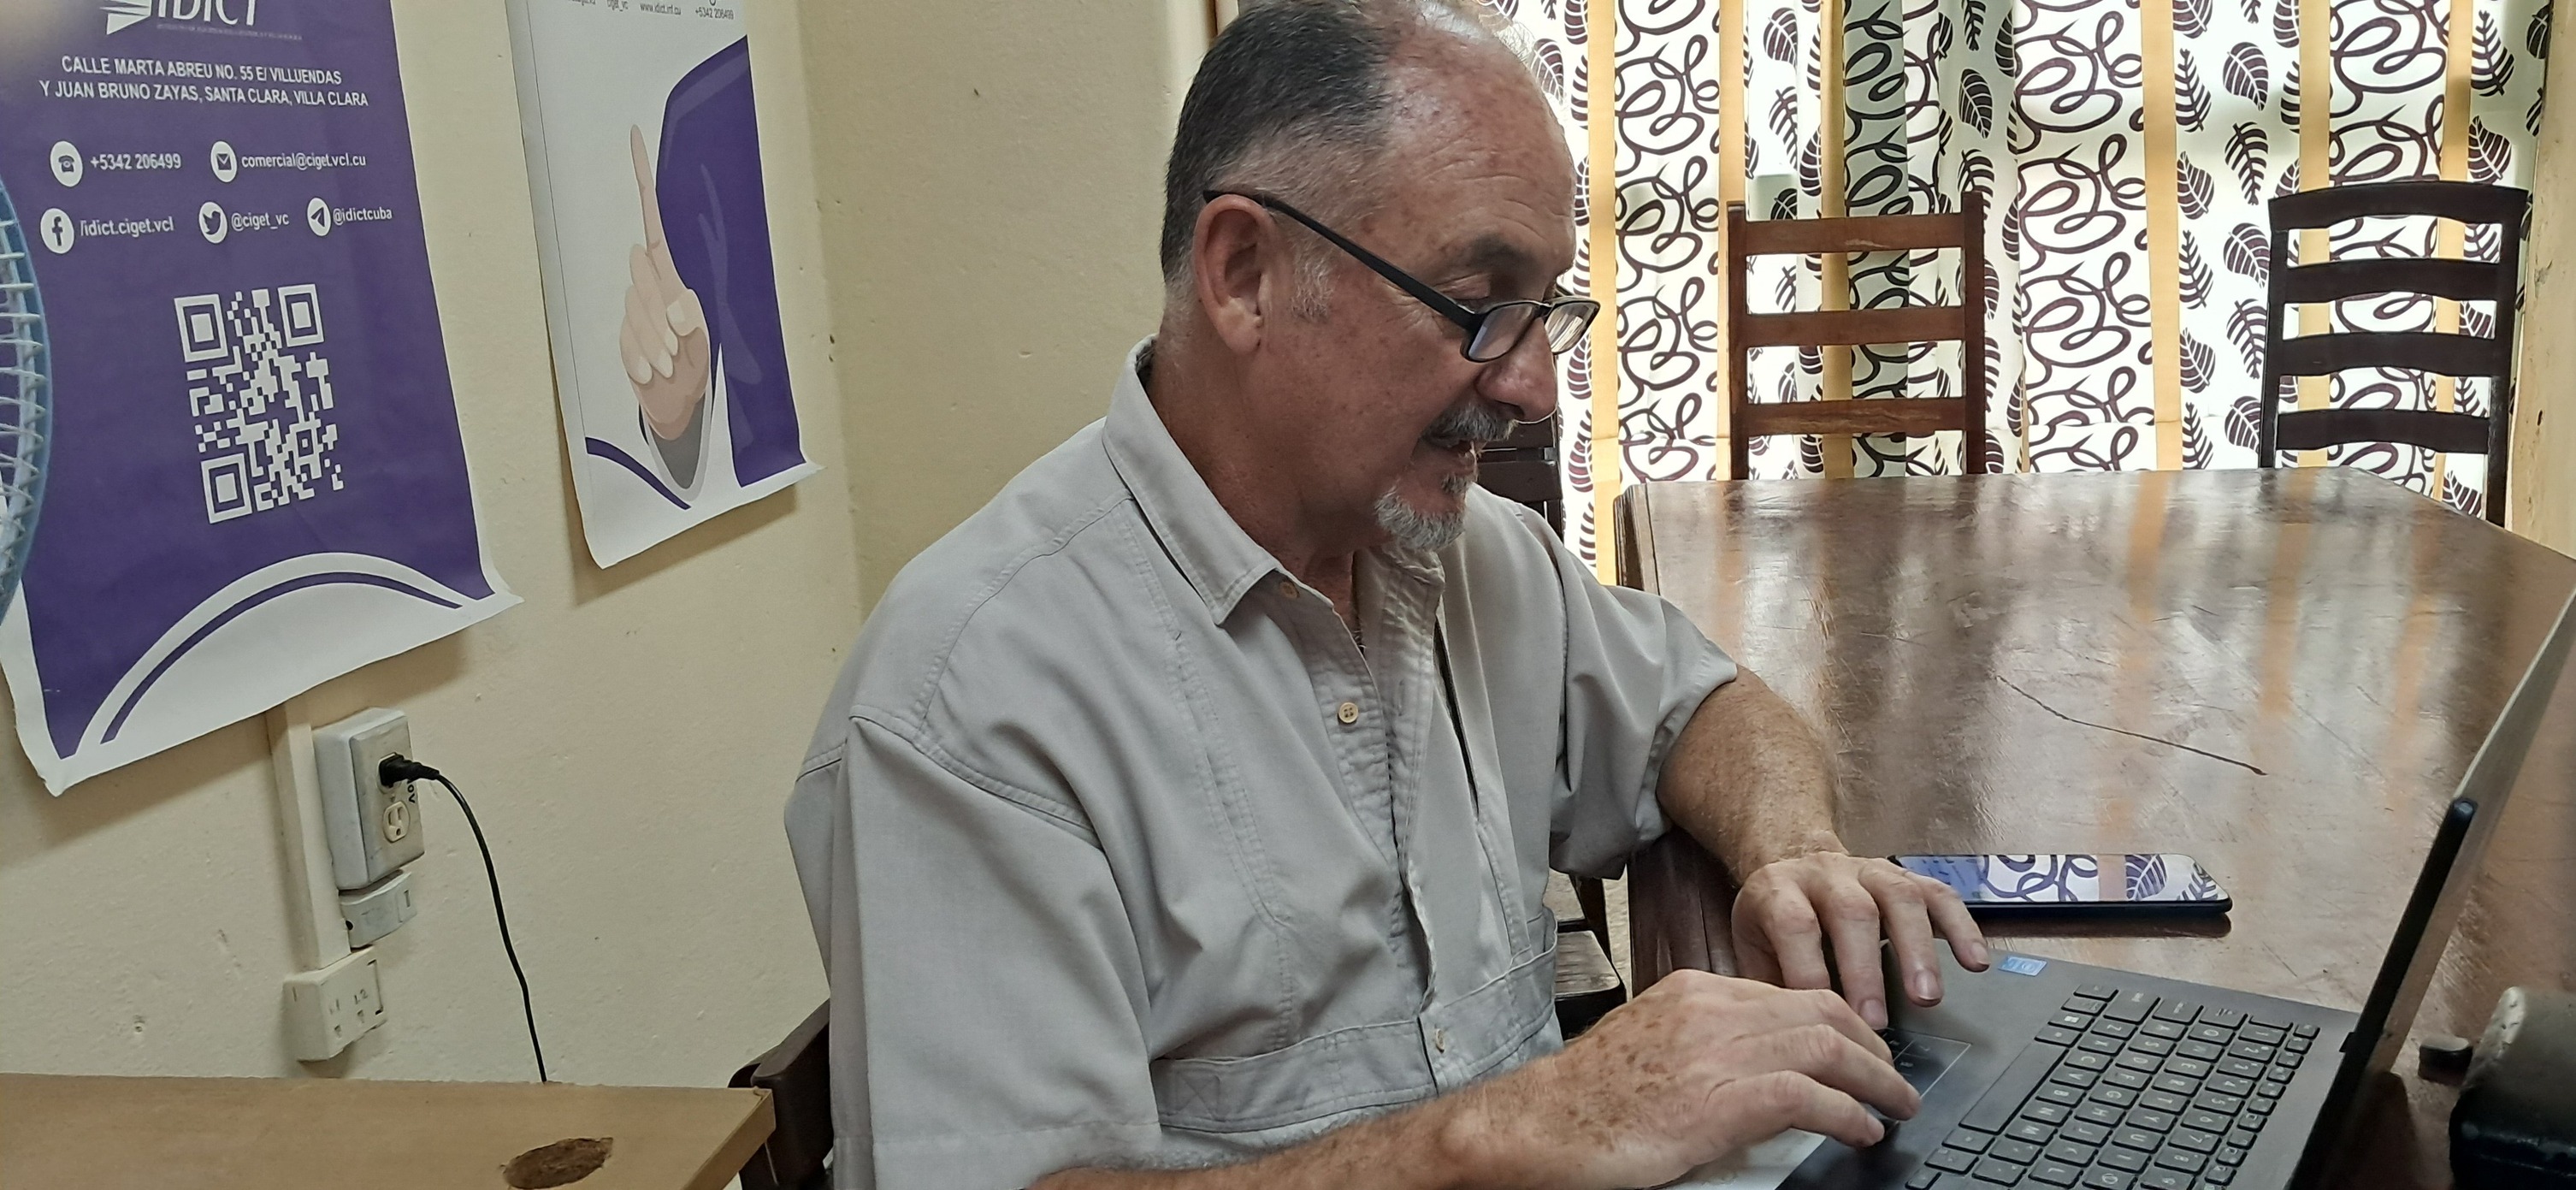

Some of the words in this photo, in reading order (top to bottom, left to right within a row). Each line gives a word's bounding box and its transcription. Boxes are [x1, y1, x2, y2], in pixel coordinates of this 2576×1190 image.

[62, 55, 111, 75] CALLE
[114, 58, 164, 77] MARTA
[167, 61, 213, 80] ABREU
[216, 65, 238, 81] NO.
[239, 65, 254, 81] 55
[269, 67, 342, 85] VILLUENDAS
[38, 80, 50, 96] Y
[54, 81, 95, 98] JUAN
[98, 83, 151, 100] BRUNO
[153, 85, 204, 104] ZAYAS,
[204, 86, 245, 103] SANTA
[249, 88, 292, 106] CLARA,
[294, 90, 326, 106] VILLA
[327, 91, 369, 107] CLARA
[91, 154, 133, 170] +5342
[135, 153, 181, 169] 206499
[241, 151, 367, 170] comercial@ciget.vcl.cu
[231, 211, 289, 232] @ciget_vc
[333, 206, 393, 225] @idictcuba
[2092, 1107, 2109, 1117] H
[2130, 1134, 2148, 1142] U
[2189, 1134, 2203, 1143] 7
